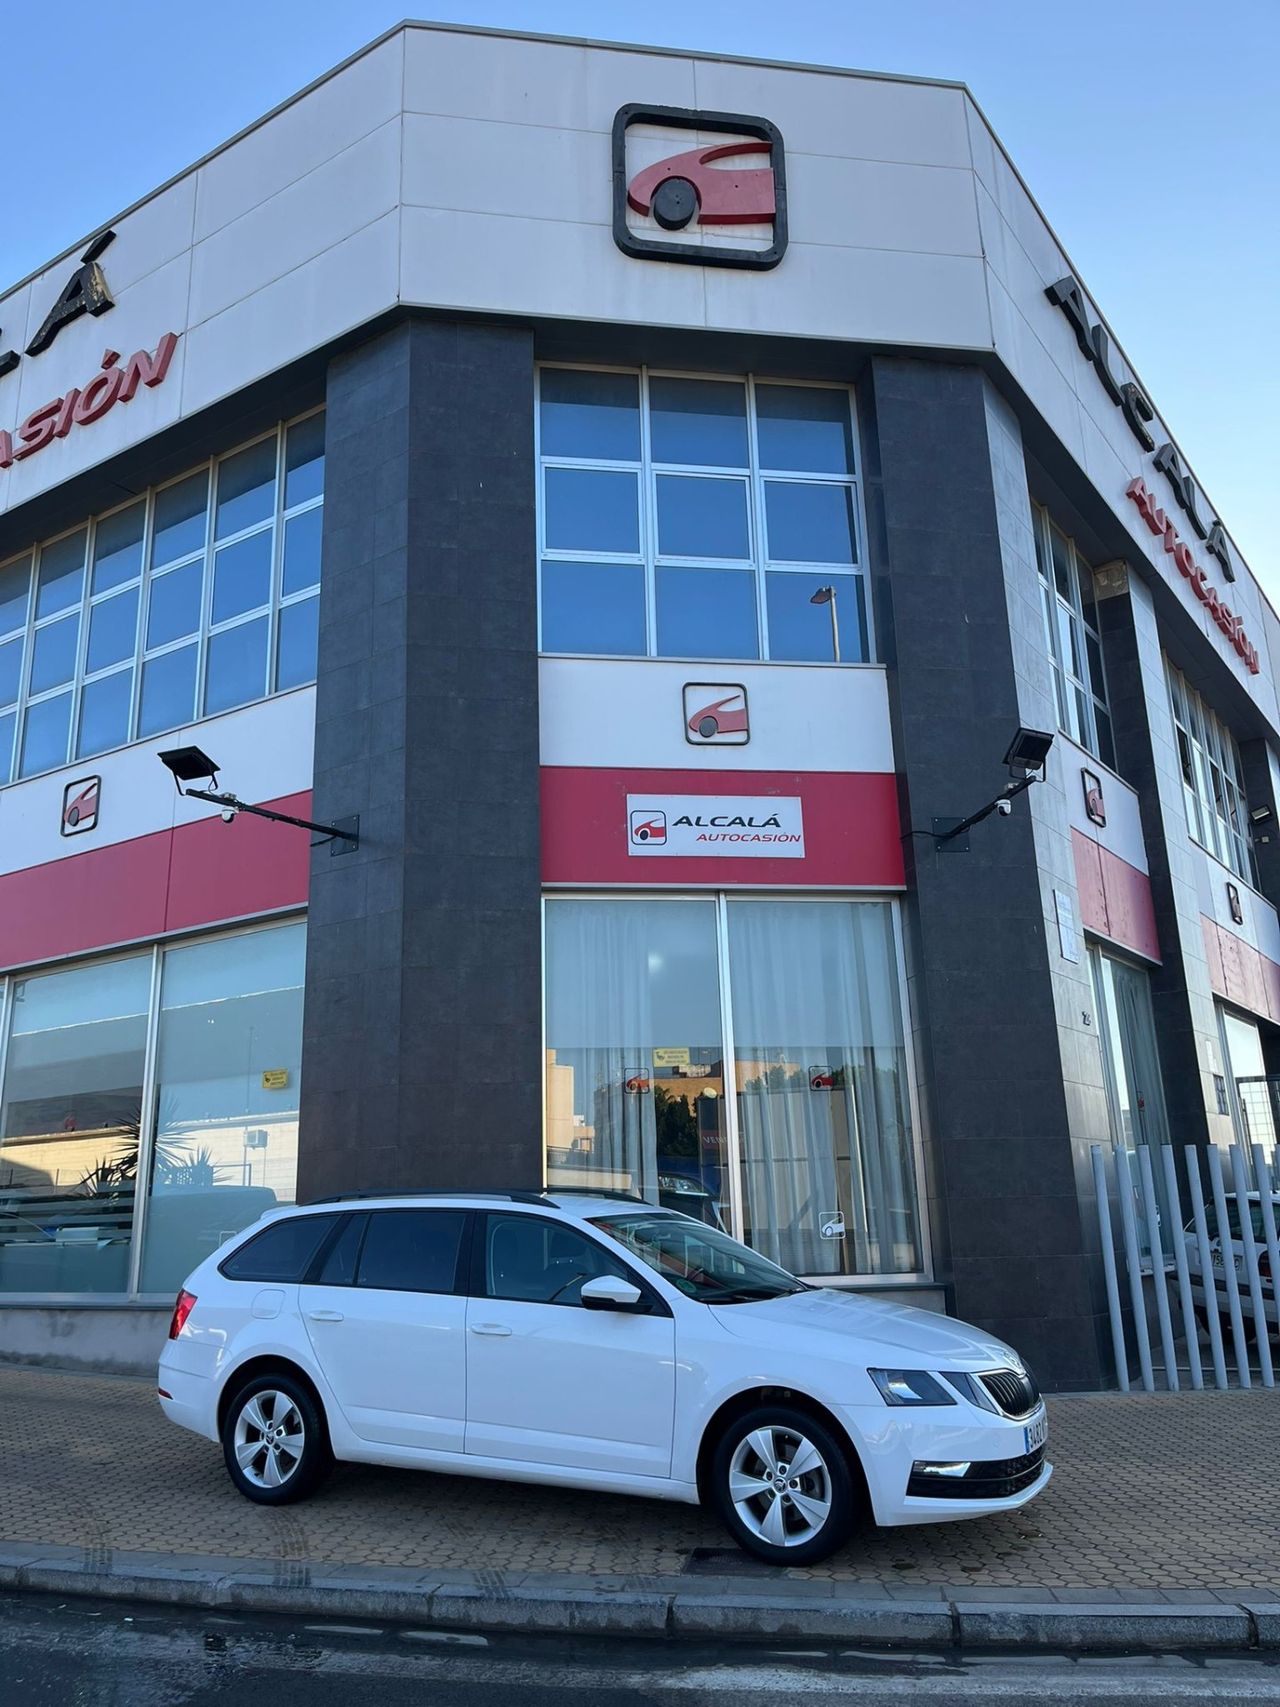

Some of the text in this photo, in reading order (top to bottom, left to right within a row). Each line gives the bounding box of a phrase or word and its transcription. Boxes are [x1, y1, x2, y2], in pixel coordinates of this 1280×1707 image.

[1044, 275, 1235, 583] ALCALÁ
[672, 813, 781, 828] ALCALÁ
[696, 832, 801, 843] AUTOCASIÓN
